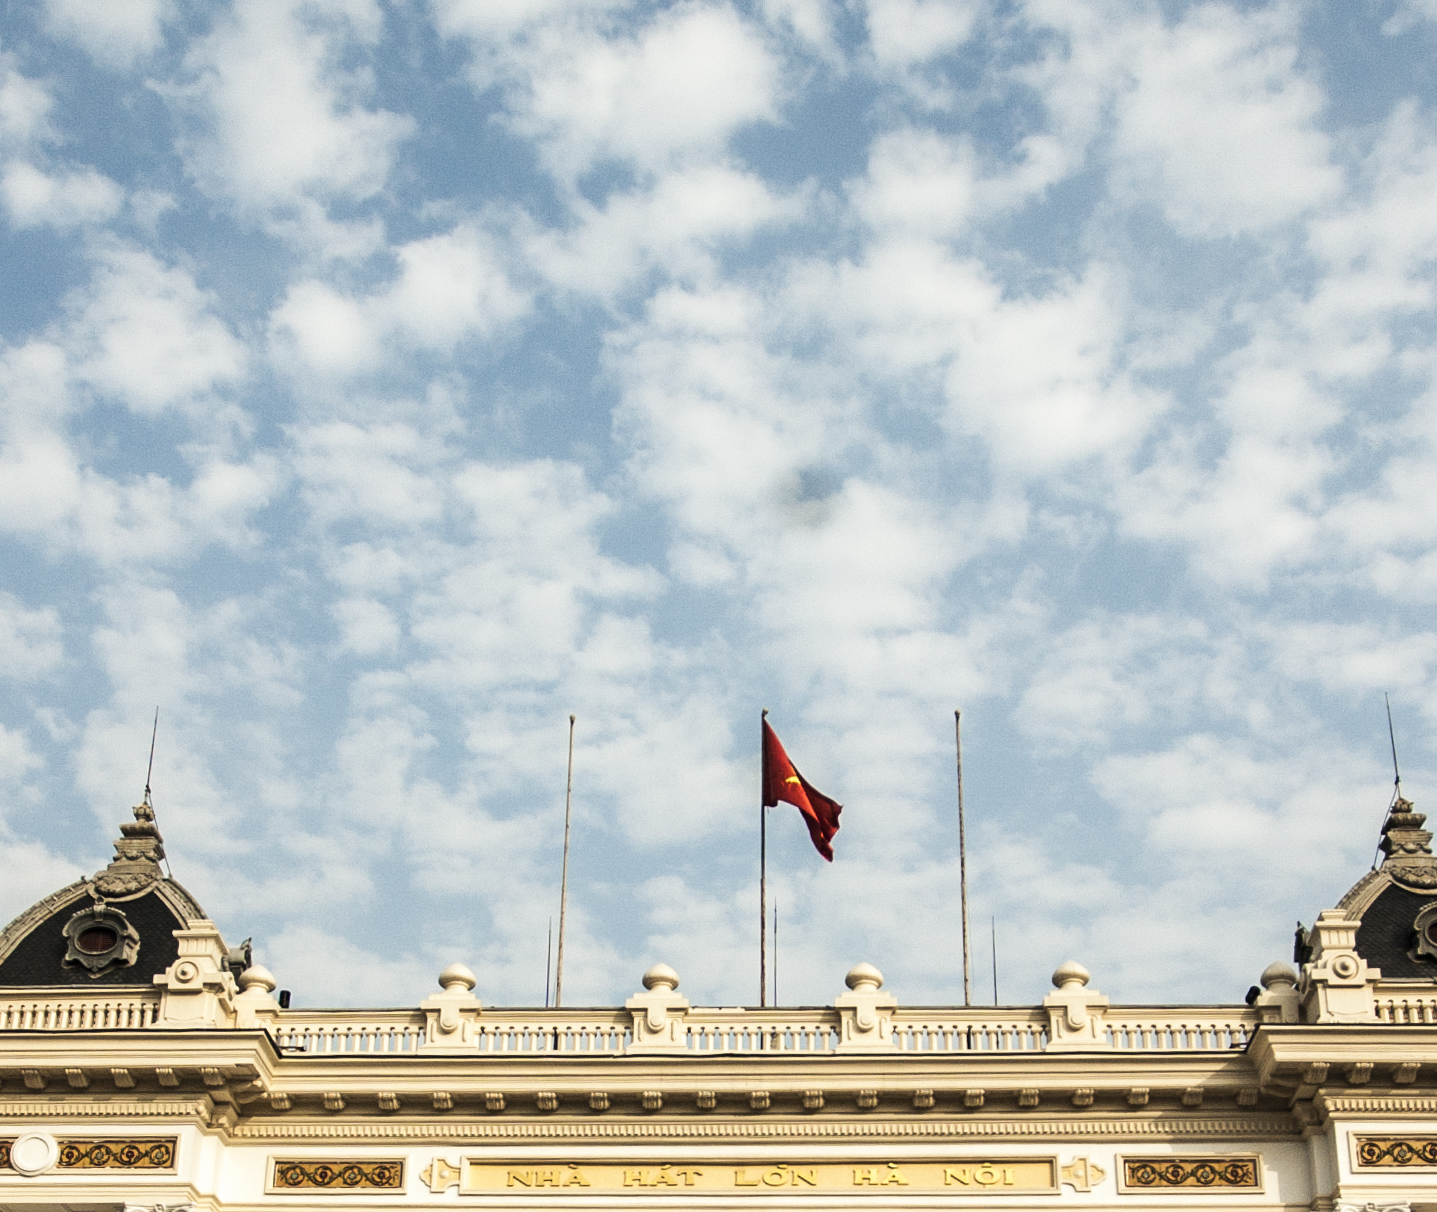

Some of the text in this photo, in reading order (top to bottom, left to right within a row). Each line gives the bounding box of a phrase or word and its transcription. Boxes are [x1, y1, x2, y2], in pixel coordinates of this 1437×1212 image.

[506, 1163, 591, 1187] NHÀ
[622, 1163, 703, 1187] HÁT
[734, 1163, 818, 1187] LỚN
[852, 1161, 910, 1186] HÀ
